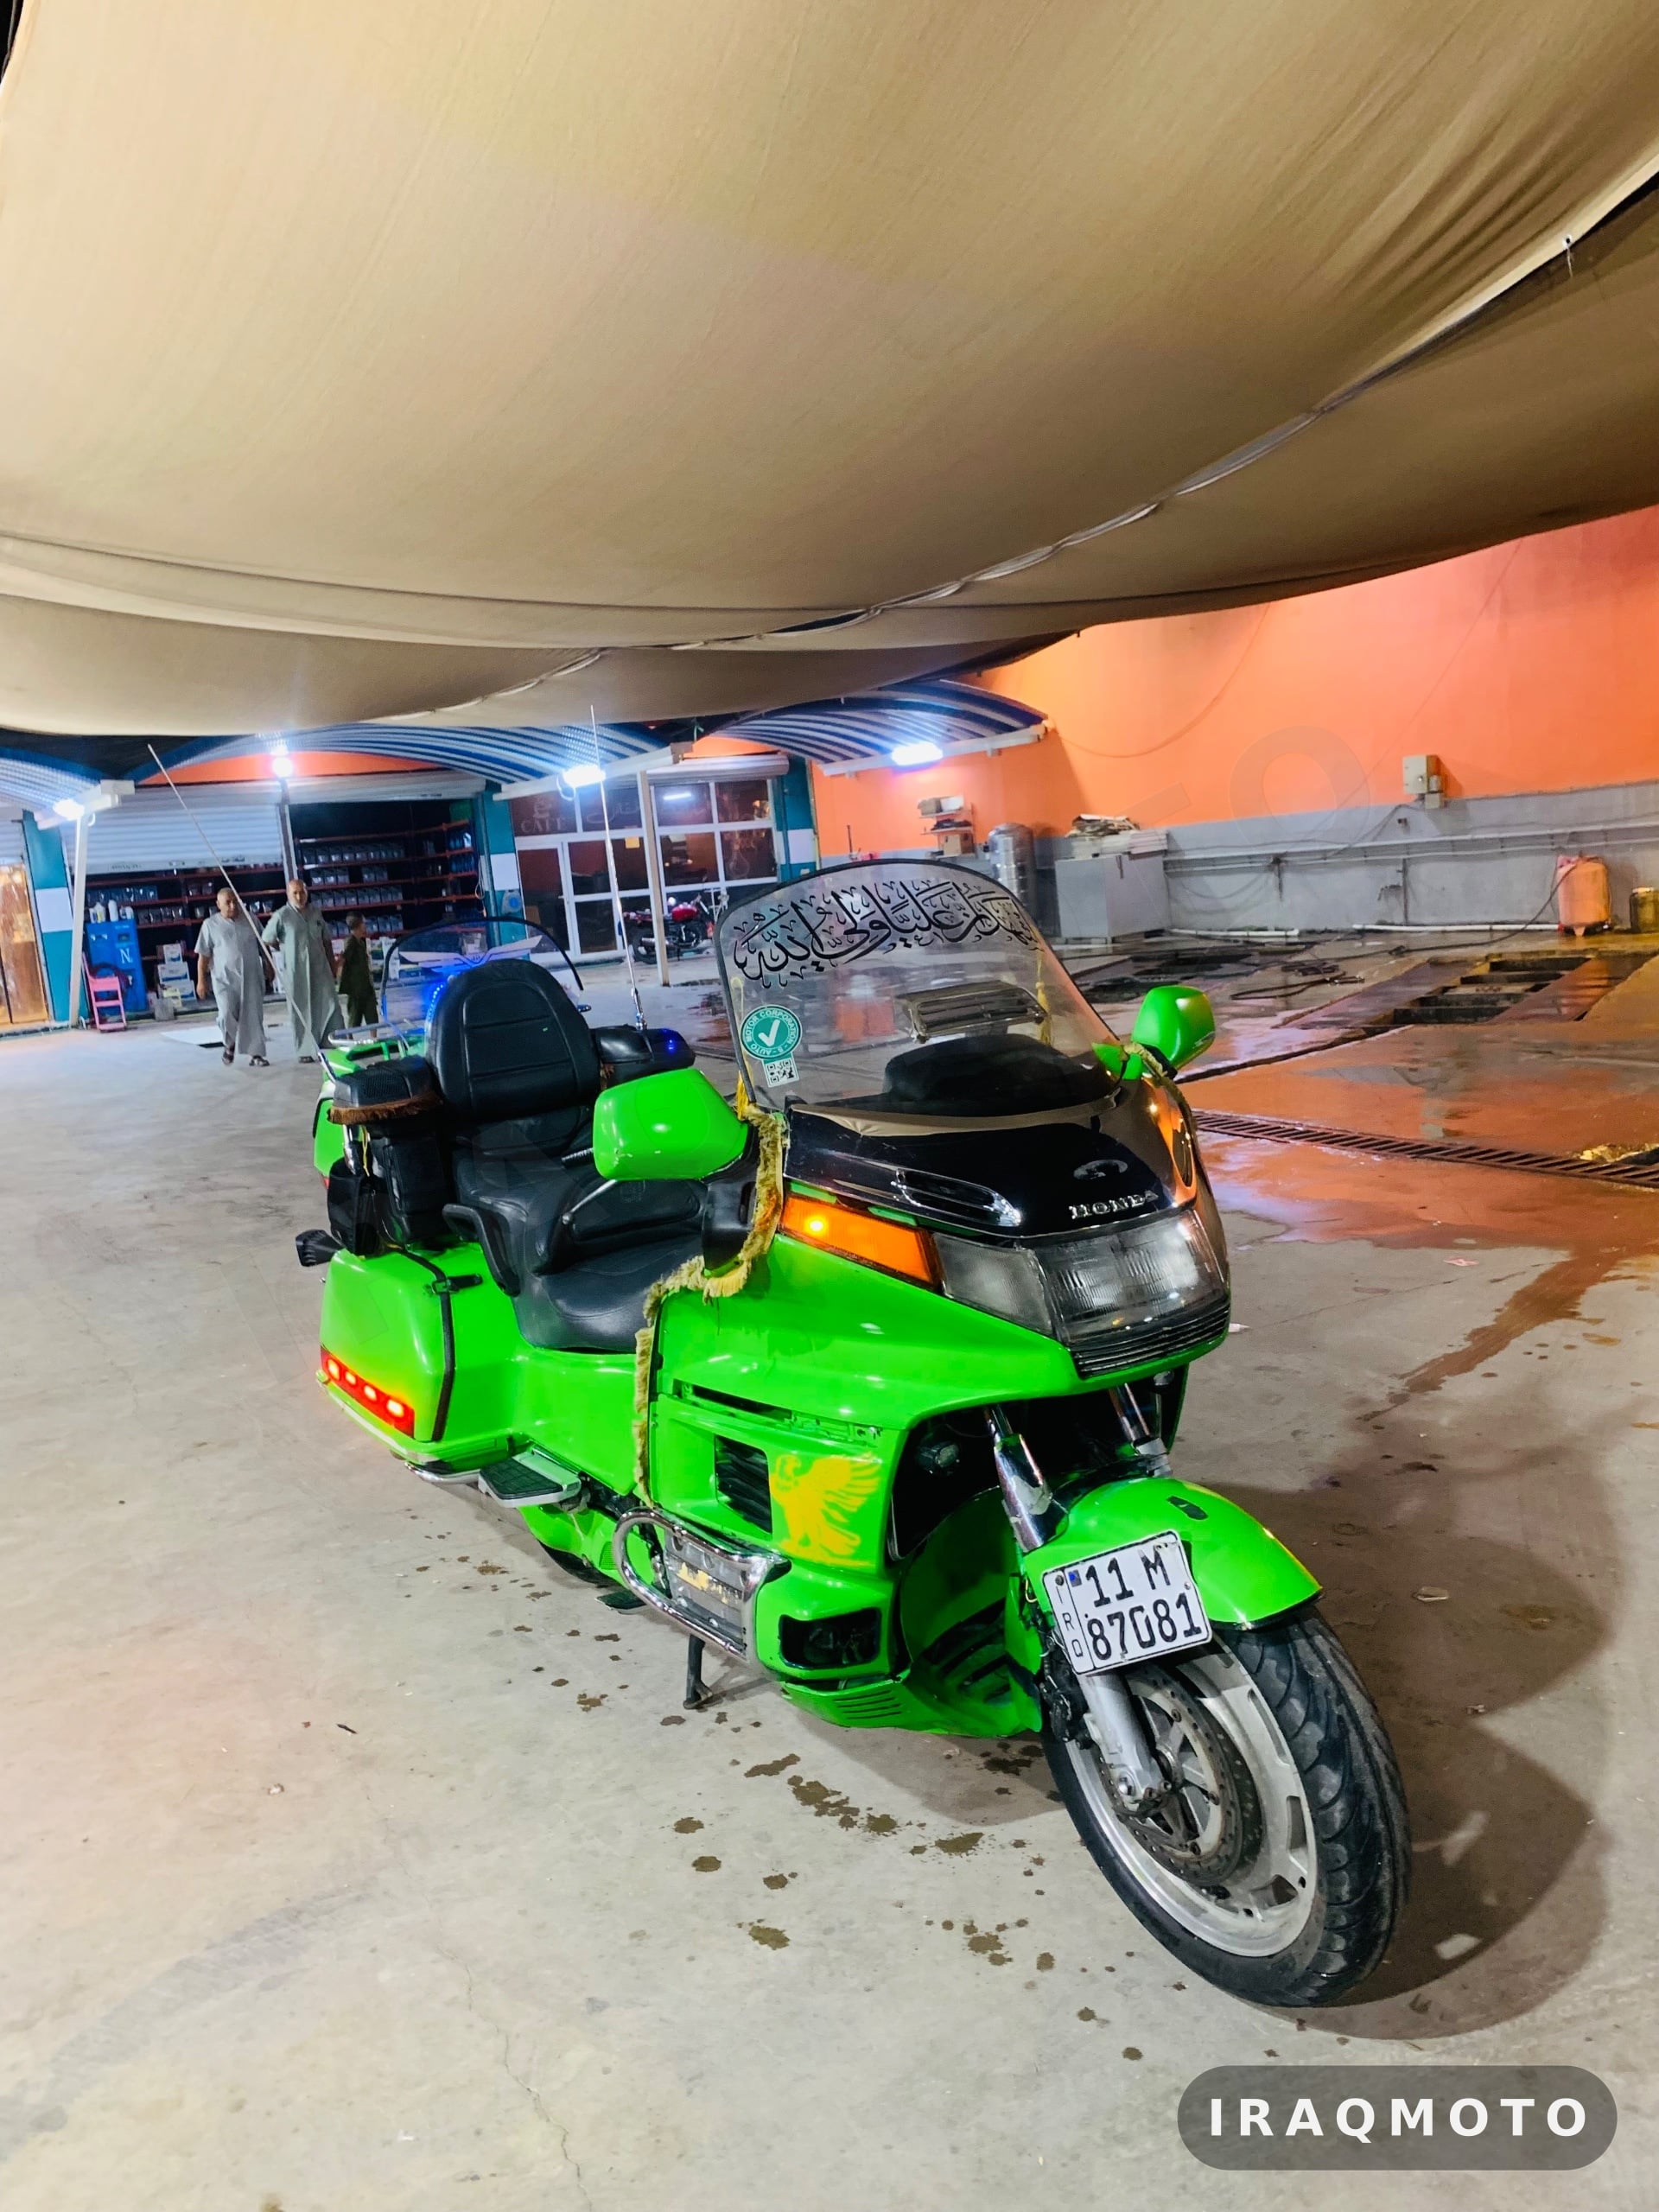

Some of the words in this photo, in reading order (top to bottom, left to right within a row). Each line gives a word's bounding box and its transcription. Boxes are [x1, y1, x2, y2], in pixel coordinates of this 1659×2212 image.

[745, 1015, 760, 1043] MOTOR
[760, 1009, 797, 1045] CORPORATION
[1069, 1190, 1159, 1219] HONDA
[1085, 1557, 1134, 1607] 11
[1137, 1544, 1171, 1590] M
[1087, 1592, 1202, 1660] 87081
